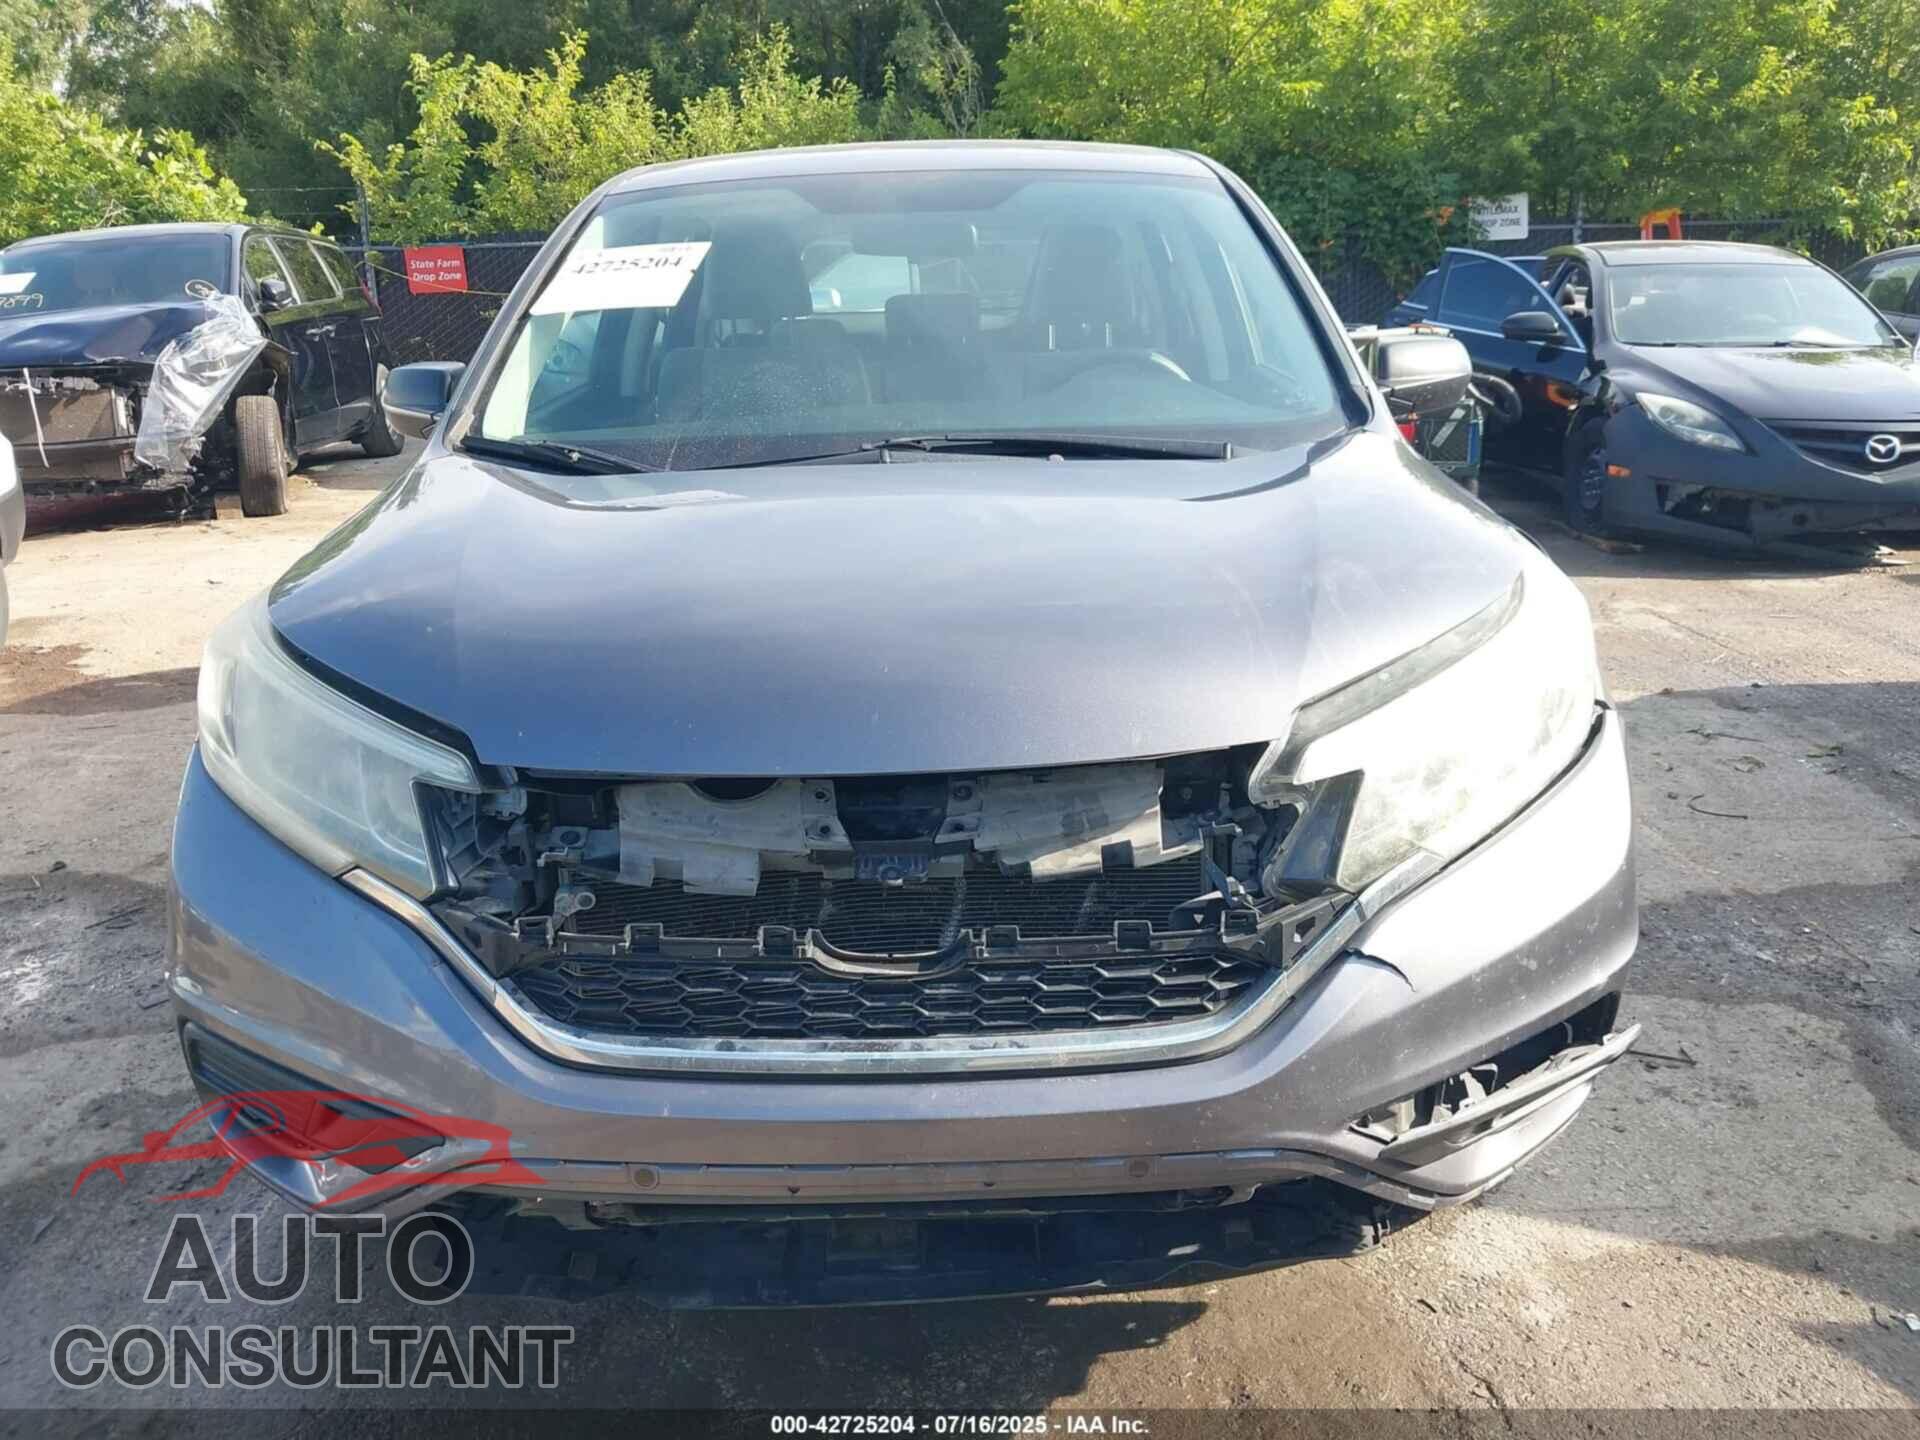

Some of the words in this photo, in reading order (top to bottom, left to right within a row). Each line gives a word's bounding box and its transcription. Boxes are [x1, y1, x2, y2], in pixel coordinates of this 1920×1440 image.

[1500, 217, 1521, 226] ZONE
[410, 259, 435, 269] State
[437, 258, 461, 268] Farm
[572, 256, 684, 275] 42725204
[412, 272, 436, 282] Drop
[438, 271, 462, 281] Zone
